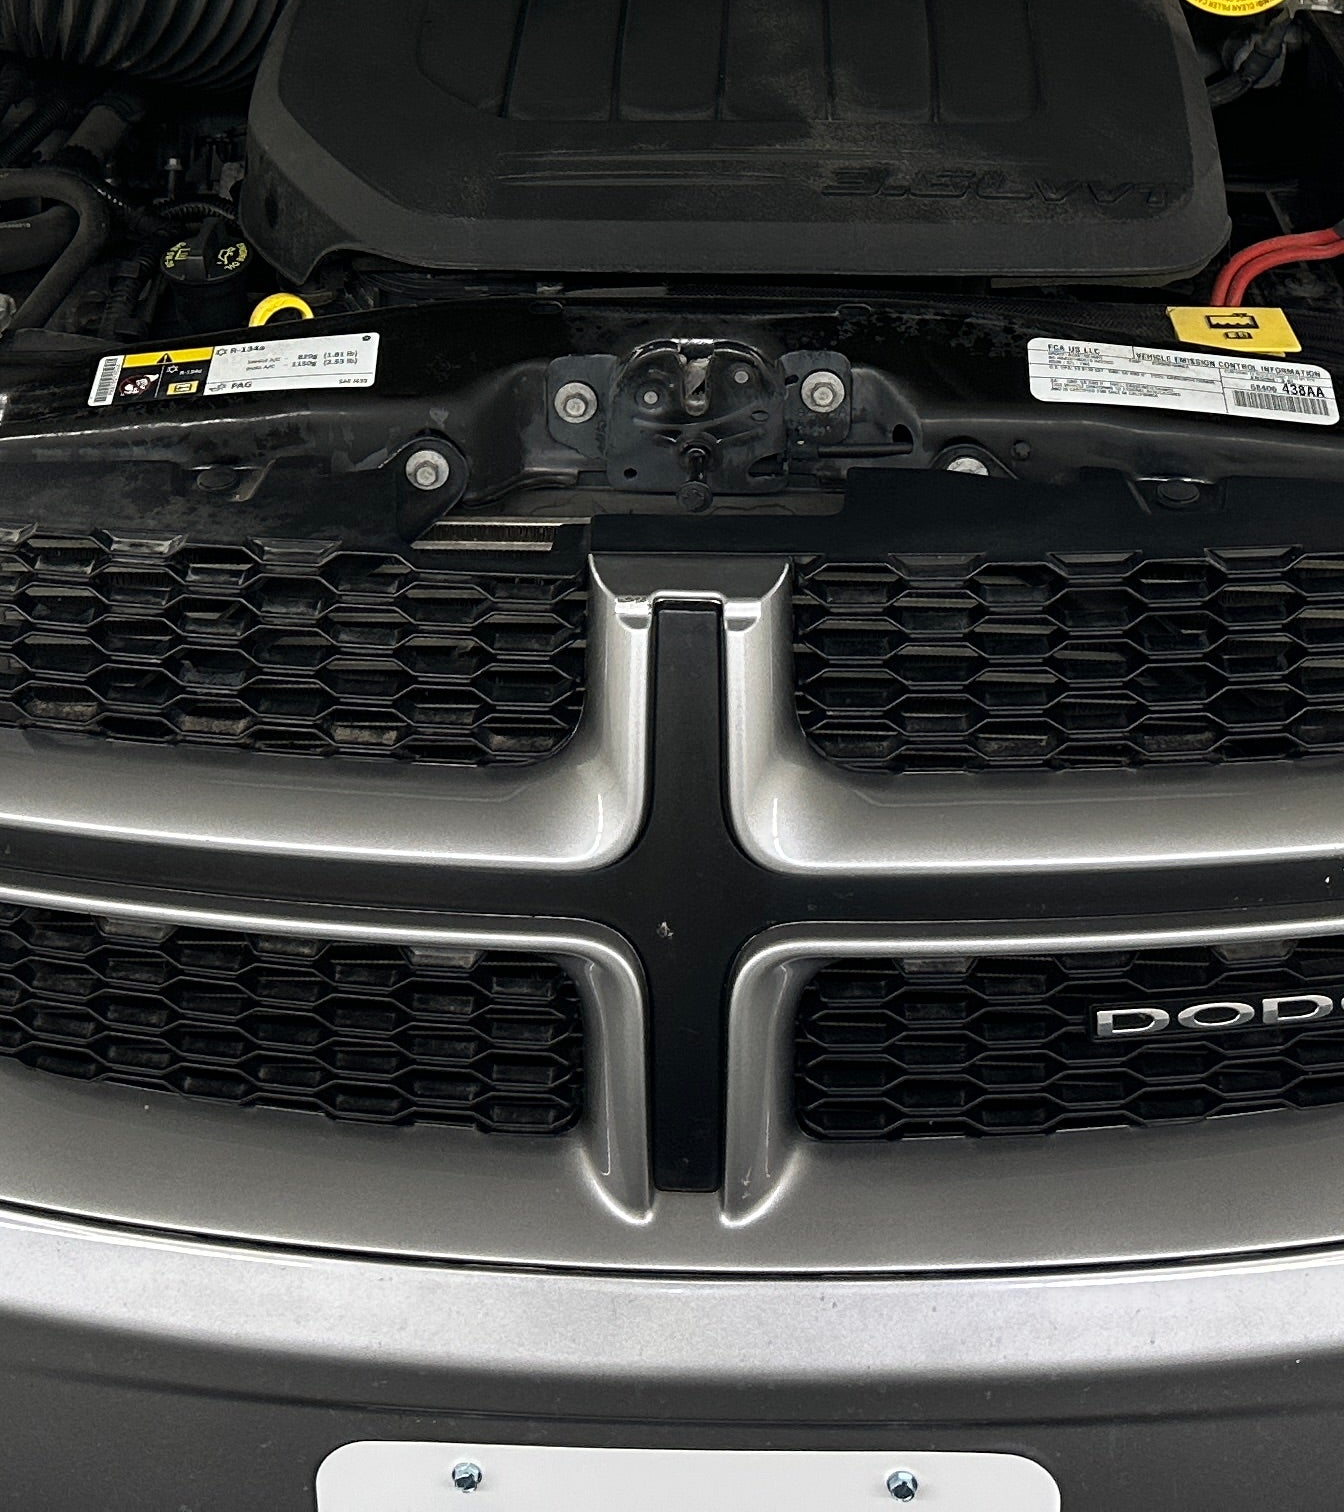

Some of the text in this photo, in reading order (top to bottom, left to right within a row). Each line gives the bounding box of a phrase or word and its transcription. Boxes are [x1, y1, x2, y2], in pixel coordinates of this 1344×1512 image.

[1047, 344, 1100, 355] FCA US LLC
[1136, 352, 1171, 362] VEHICLE
[1174, 356, 1215, 368] EMISSION
[1218, 361, 1258, 372] CONTROL
[1261, 366, 1321, 378] INFORMATION
[1282, 383, 1326, 398] 438AA
